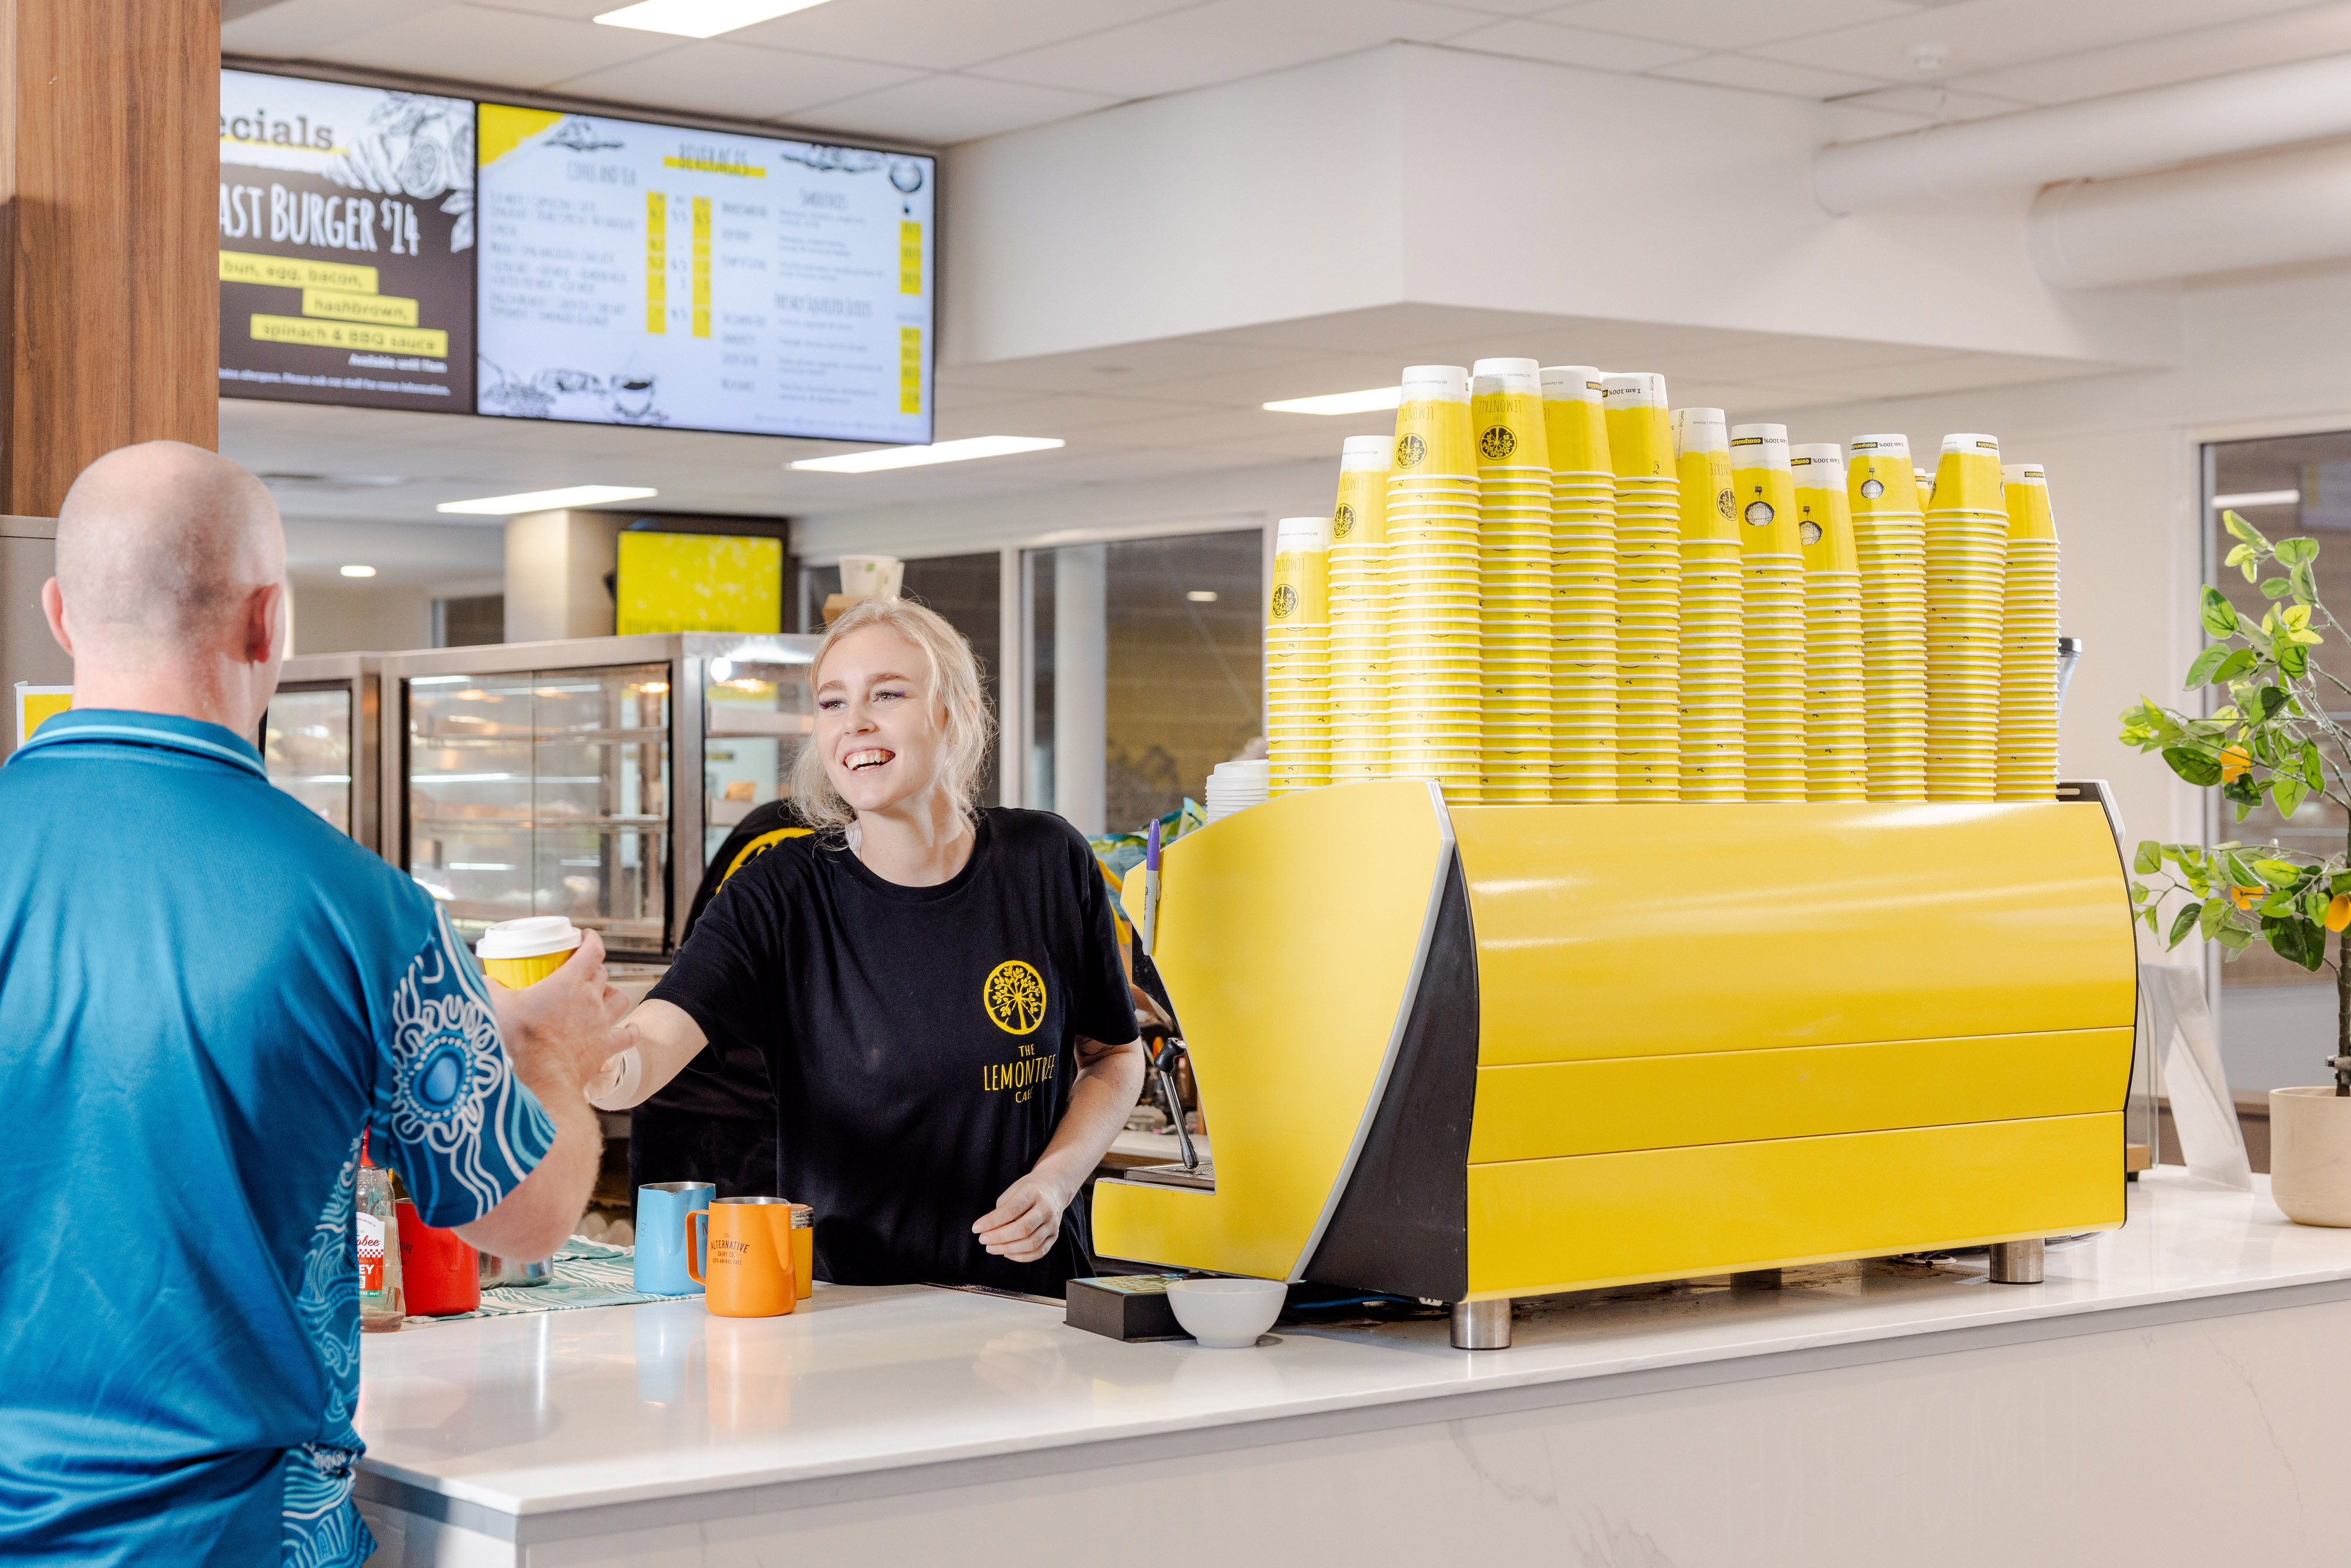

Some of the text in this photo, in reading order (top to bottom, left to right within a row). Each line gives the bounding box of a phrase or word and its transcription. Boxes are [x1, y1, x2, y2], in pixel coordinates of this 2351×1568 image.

[270, 183, 378, 253] BURGER
[380, 197, 421, 256] $14
[309, 266, 363, 287] bacon,
[314, 300, 408, 321] hashbrown,
[263, 323, 436, 350] spinach & BBQ sauce
[1478, 399, 1521, 414] LEMONTREE
[1018, 1044, 1035, 1057] THE
[984, 1054, 1056, 1091] LEMONTREE
[400, 1241, 414, 1254] TIVE
[711, 1239, 750, 1254] ALTERNATIVE
[359, 1264, 374, 1275] EY
